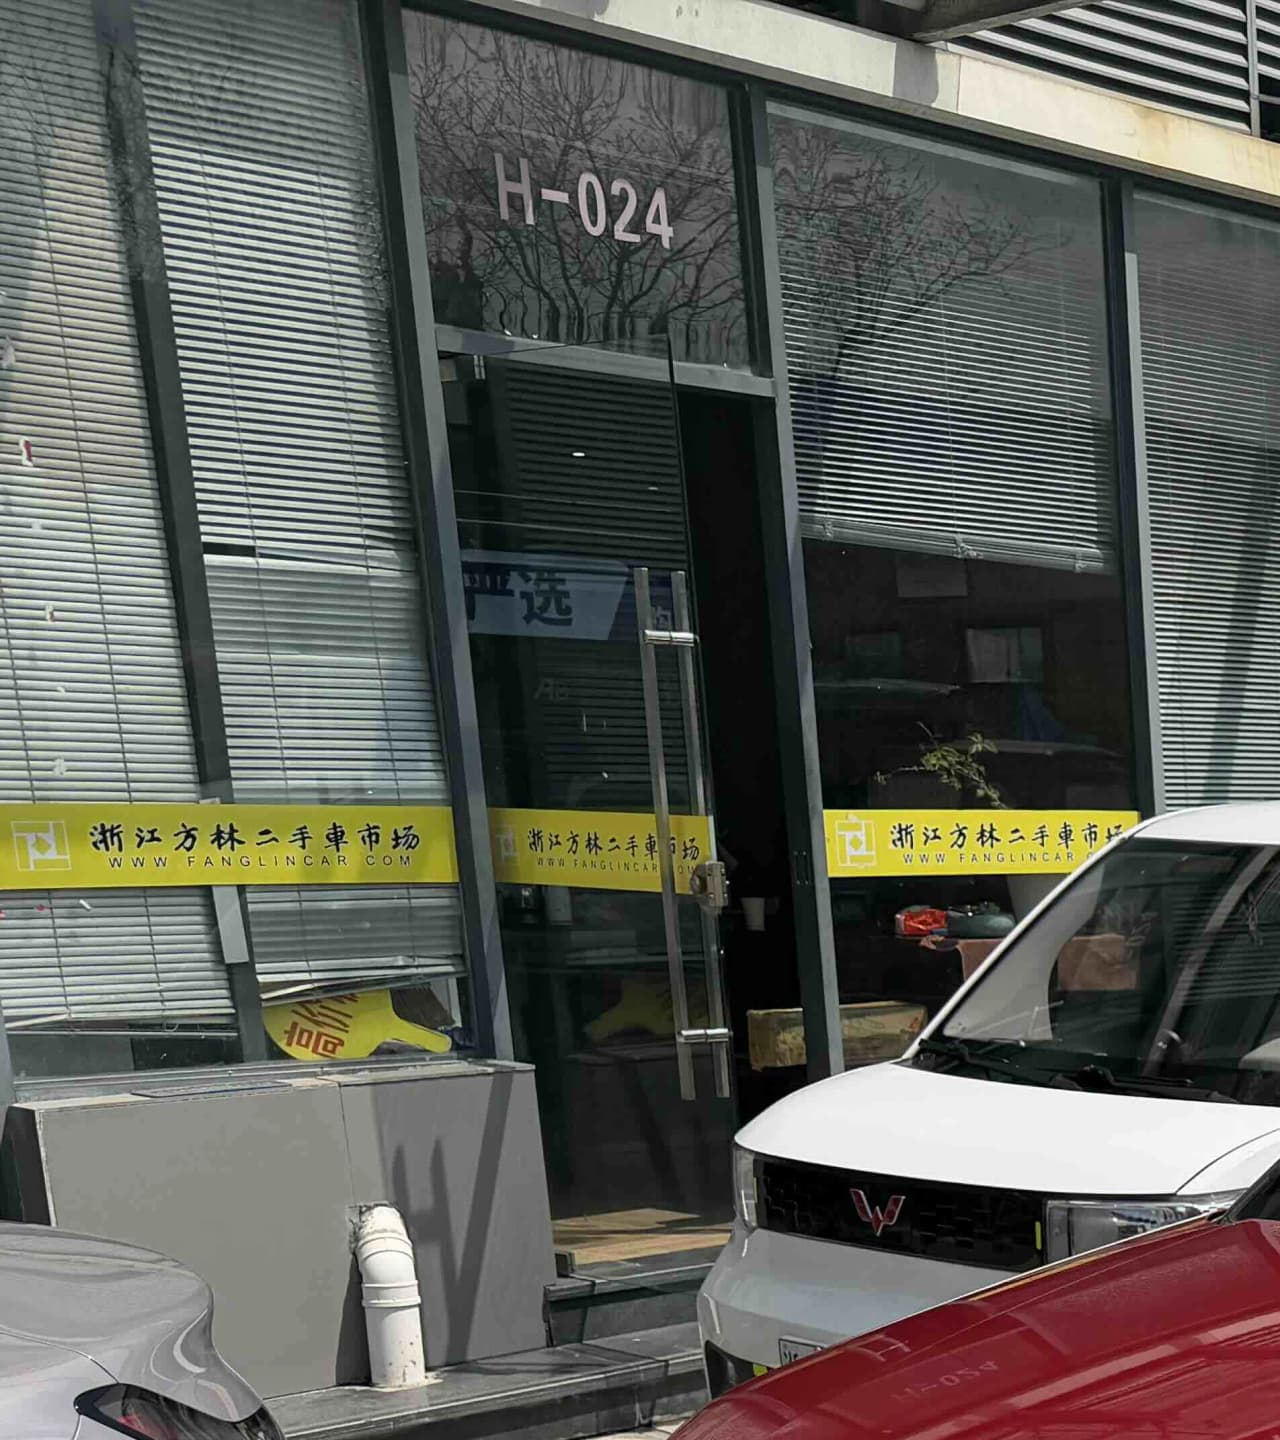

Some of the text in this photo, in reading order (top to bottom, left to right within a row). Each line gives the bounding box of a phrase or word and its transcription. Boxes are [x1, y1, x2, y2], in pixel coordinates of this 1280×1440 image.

[494, 153, 675, 249] H-024
[91, 822, 420, 852] 浙江方林二手車市场
[187, 855, 350, 868] FANGLINCAR
[366, 854, 413, 867] COM
[960, 852, 1075, 863] FANGLINCAR
[573, 859, 658, 873] FANGLINCAR
